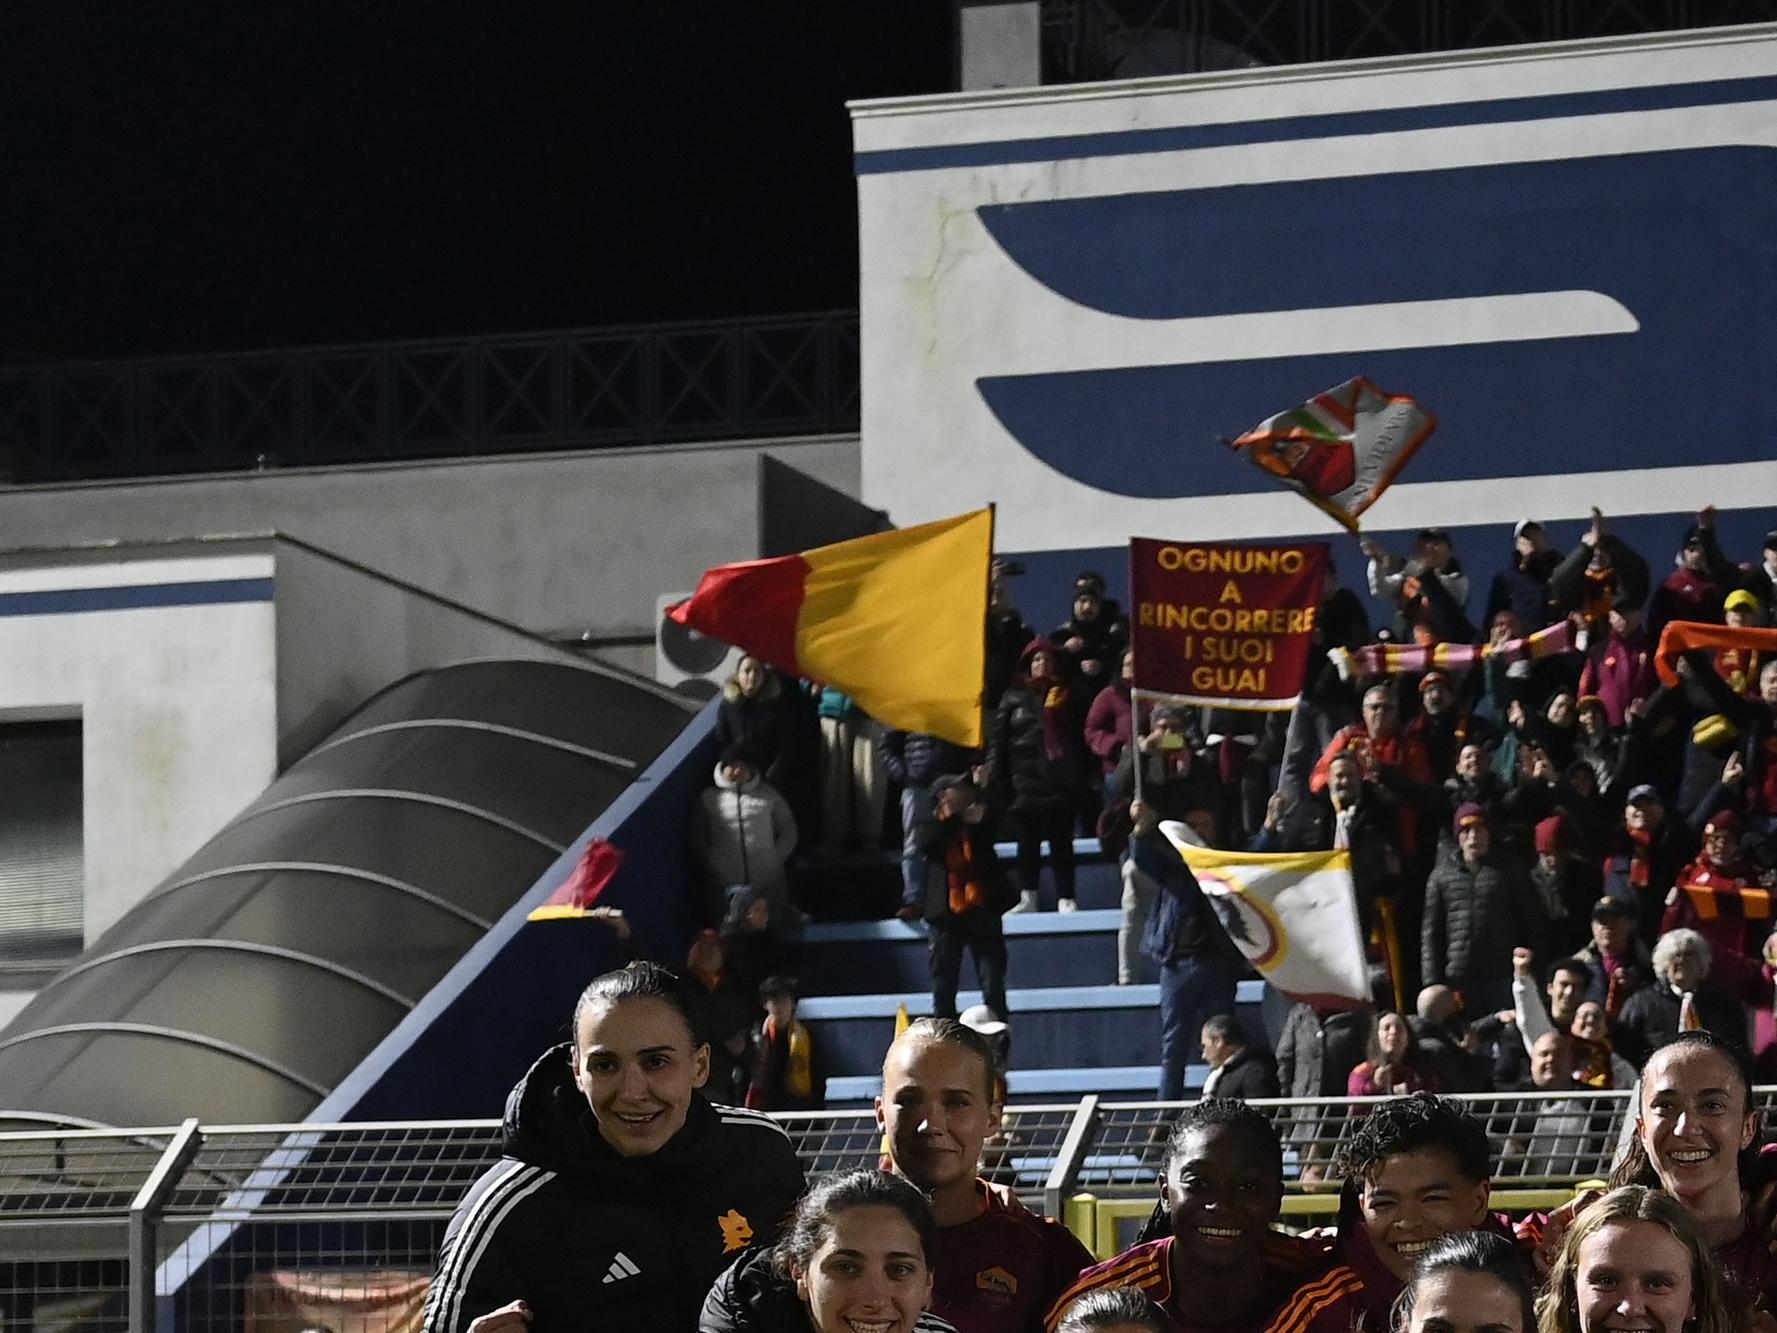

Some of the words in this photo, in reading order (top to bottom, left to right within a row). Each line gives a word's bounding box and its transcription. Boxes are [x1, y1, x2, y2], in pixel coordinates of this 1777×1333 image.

[1157, 546, 1306, 575] OGNUNO
[1218, 579, 1243, 604] A
[1138, 601, 1317, 634] RINCORRERE
[1184, 635, 1194, 660] I
[1201, 636, 1276, 663] SUOI
[1191, 666, 1268, 692] GUAI
